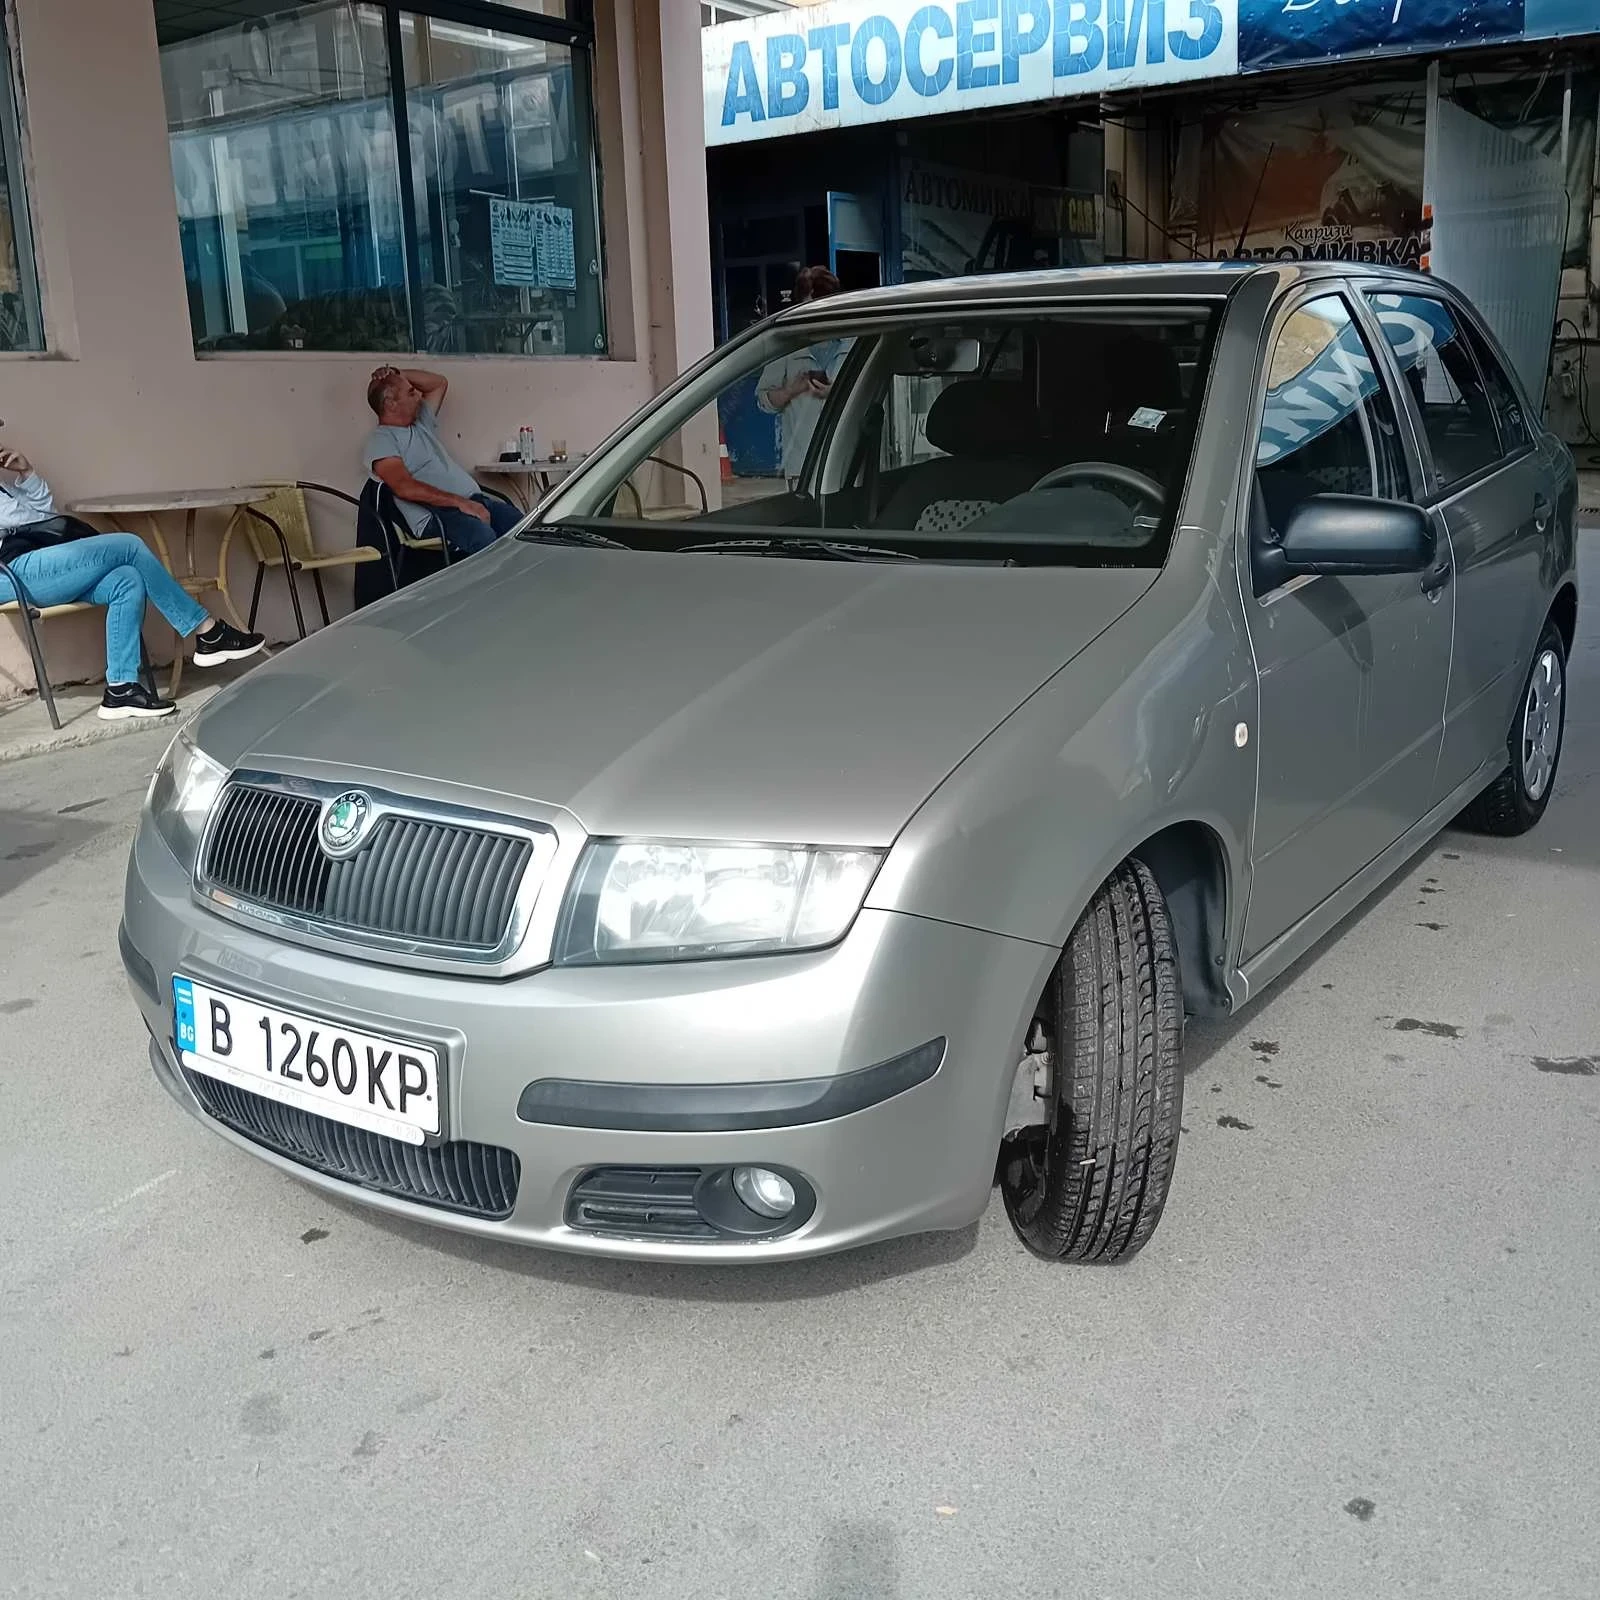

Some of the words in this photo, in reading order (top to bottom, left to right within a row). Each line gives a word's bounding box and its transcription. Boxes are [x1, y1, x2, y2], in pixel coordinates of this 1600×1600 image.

[721, 0, 1223, 127] АВТОСЕРВИЗ
[180, 1021, 194, 1042] BG
[209, 997, 233, 1057] B
